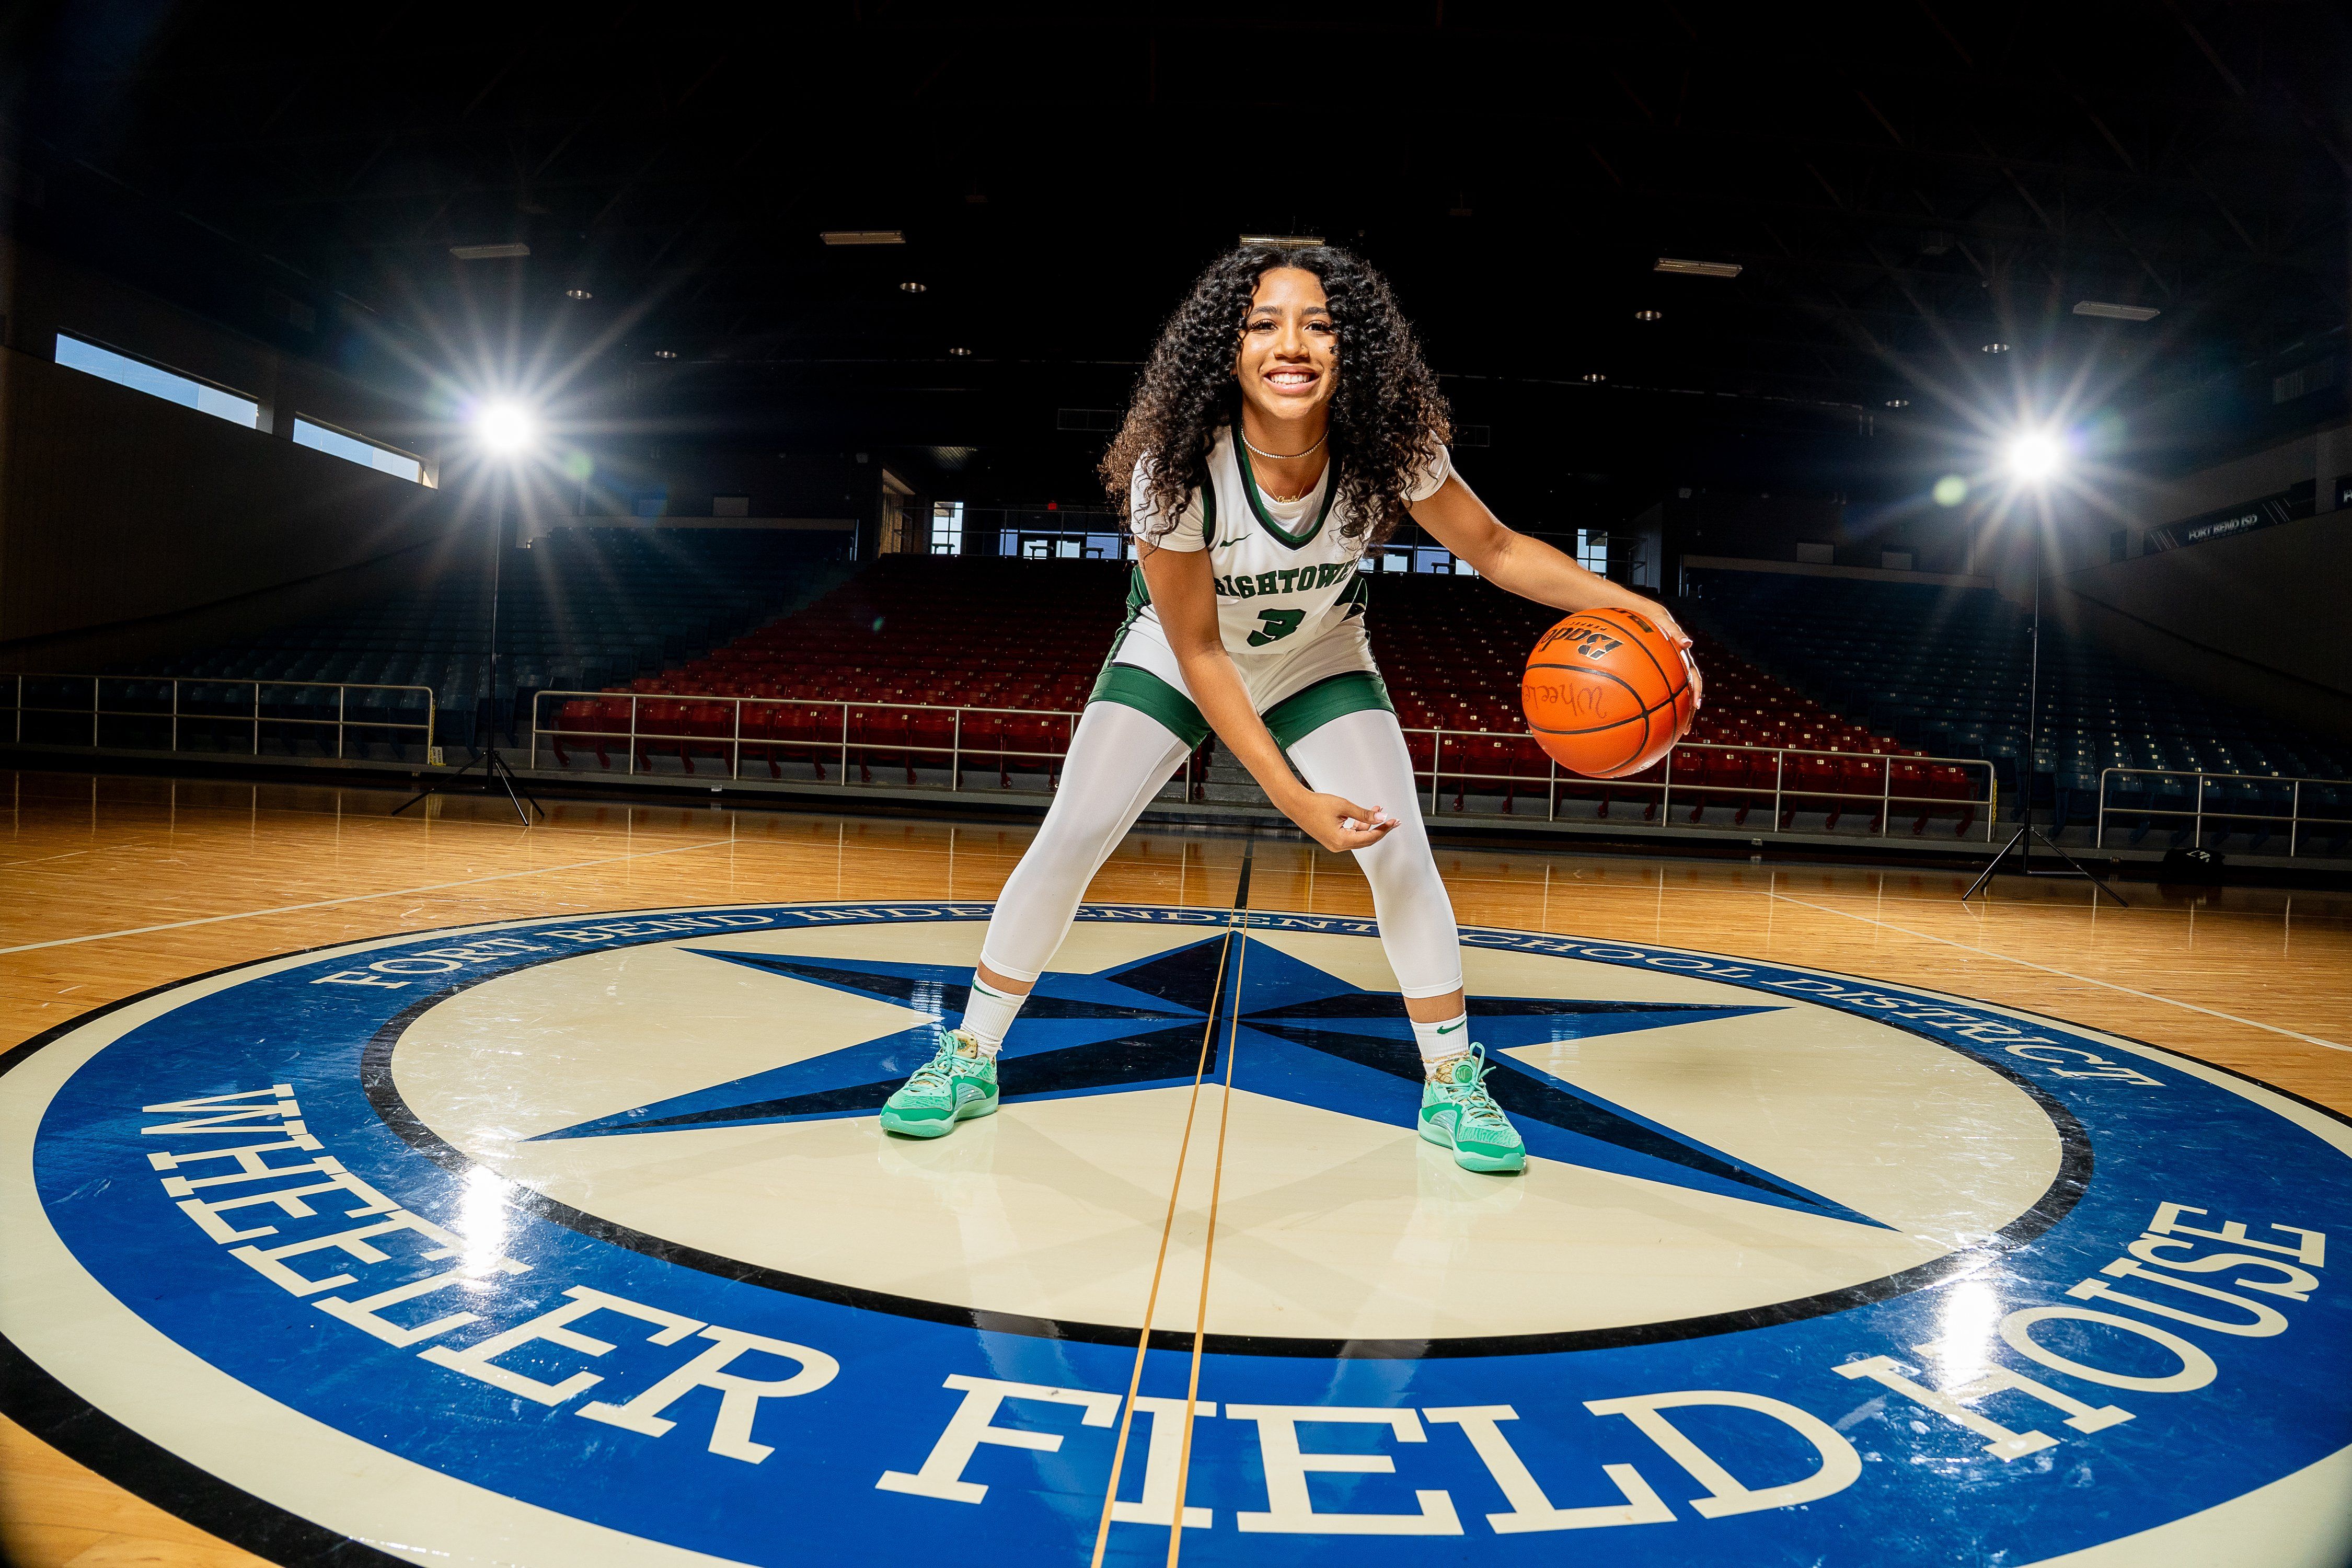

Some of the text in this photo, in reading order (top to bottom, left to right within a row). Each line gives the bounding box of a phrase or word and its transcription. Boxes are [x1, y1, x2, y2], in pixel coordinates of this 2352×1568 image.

[2241, 514, 2257, 527] ISD
[1213, 553, 1363, 600] IGHTOWE
[1246, 608, 1307, 648] 3
[309, 908, 2166, 1087] FORT BEND INDENDENT CHOOL DISTRICT
[141, 1084, 2326, 1536] WHEELER FIELD HOUSE
